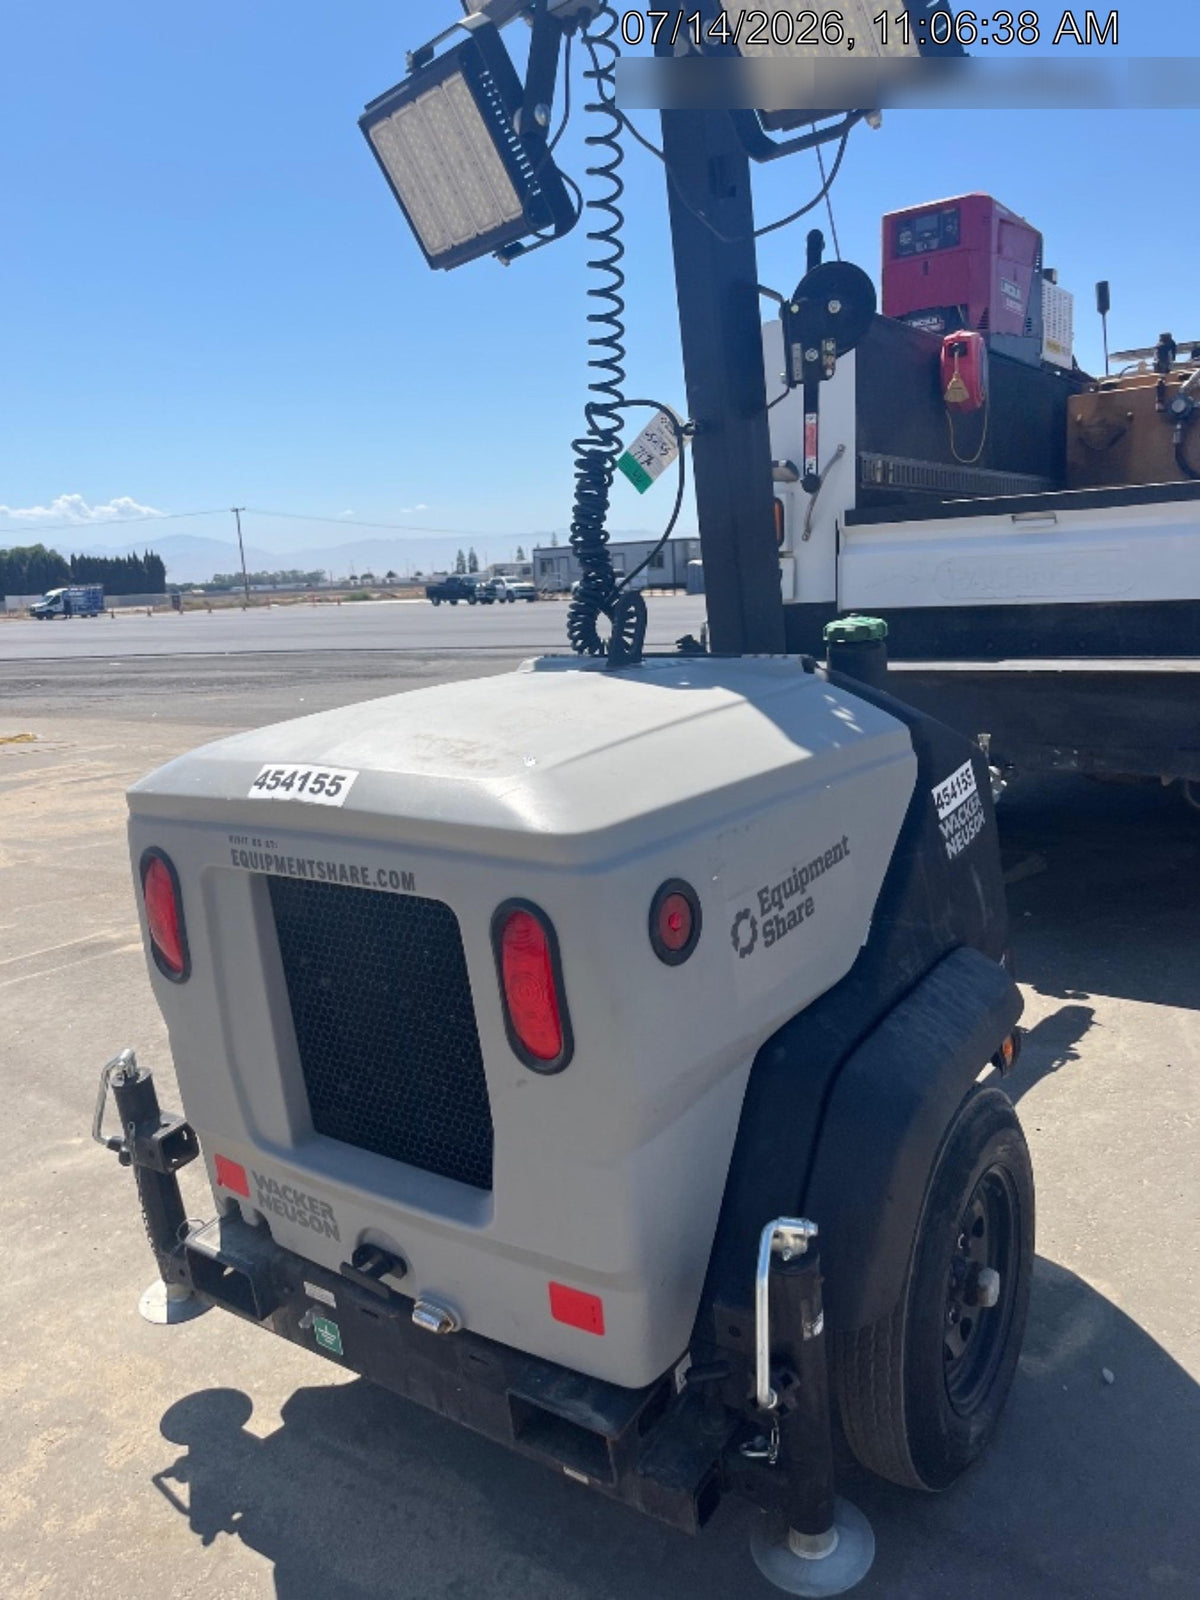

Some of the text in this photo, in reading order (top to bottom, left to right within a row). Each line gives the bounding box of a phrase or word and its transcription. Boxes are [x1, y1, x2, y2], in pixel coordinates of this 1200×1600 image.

[253, 769, 347, 797] 454155
[935, 767, 973, 810] 454155
[939, 791, 982, 838] WACKER
[945, 809, 986, 860] NEUSON
[230, 849, 417, 892] EQUIPMENTSHARE.COM
[757, 834, 851, 917] Equipment
[762, 896, 816, 948] Share
[252, 1169, 336, 1222] WACKER
[257, 1192, 341, 1243] NEUSON
